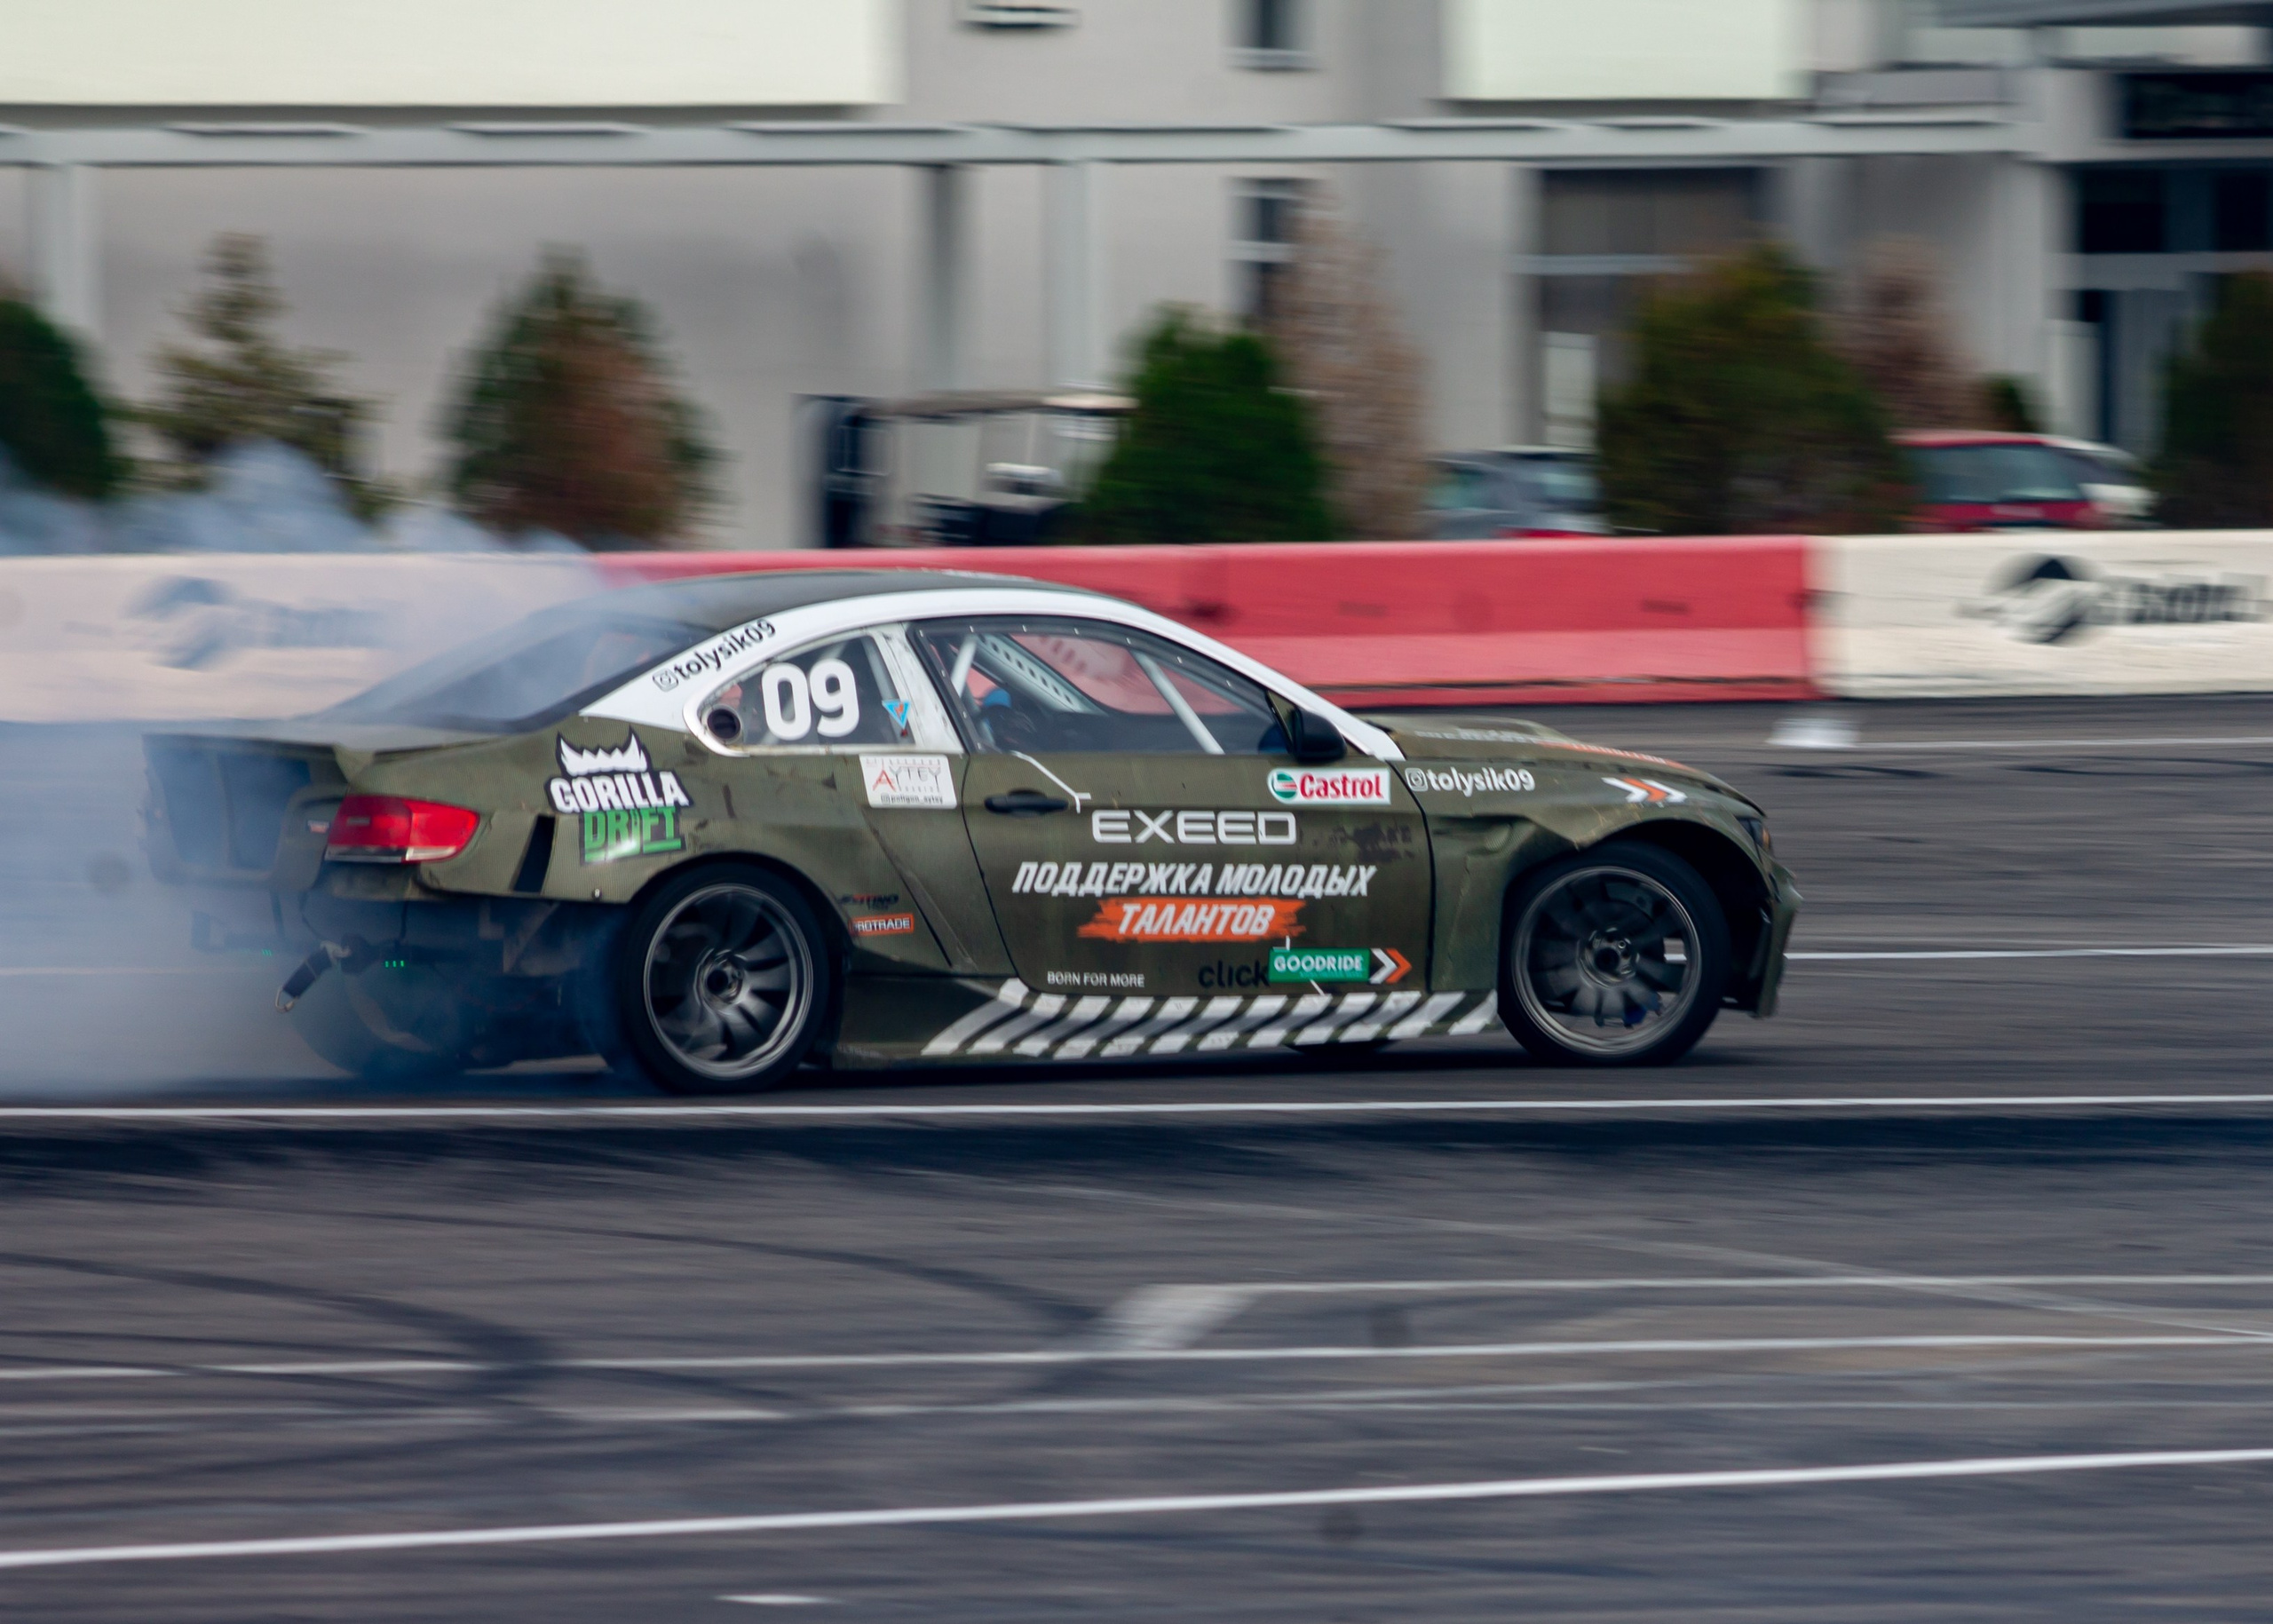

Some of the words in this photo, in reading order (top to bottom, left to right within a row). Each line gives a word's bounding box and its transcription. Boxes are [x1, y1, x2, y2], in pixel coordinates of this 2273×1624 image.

[761, 660, 860, 741] 09
[550, 771, 690, 813] GORILLA
[1300, 772, 1383, 800] Castrol
[583, 805, 682, 863] DRIFT
[1092, 810, 1296, 844] EXEED
[1011, 861, 1212, 897] ПОДДЕРЖКА
[1215, 863, 1377, 899] МОЛОДЫХ
[1118, 902, 1275, 936] ТАЛАНТОВ
[1047, 970, 1081, 986] BORN
[1083, 972, 1107, 986] FOR
[1110, 973, 1145, 988] MORE
[1273, 955, 1364, 973] GOODRIDE
